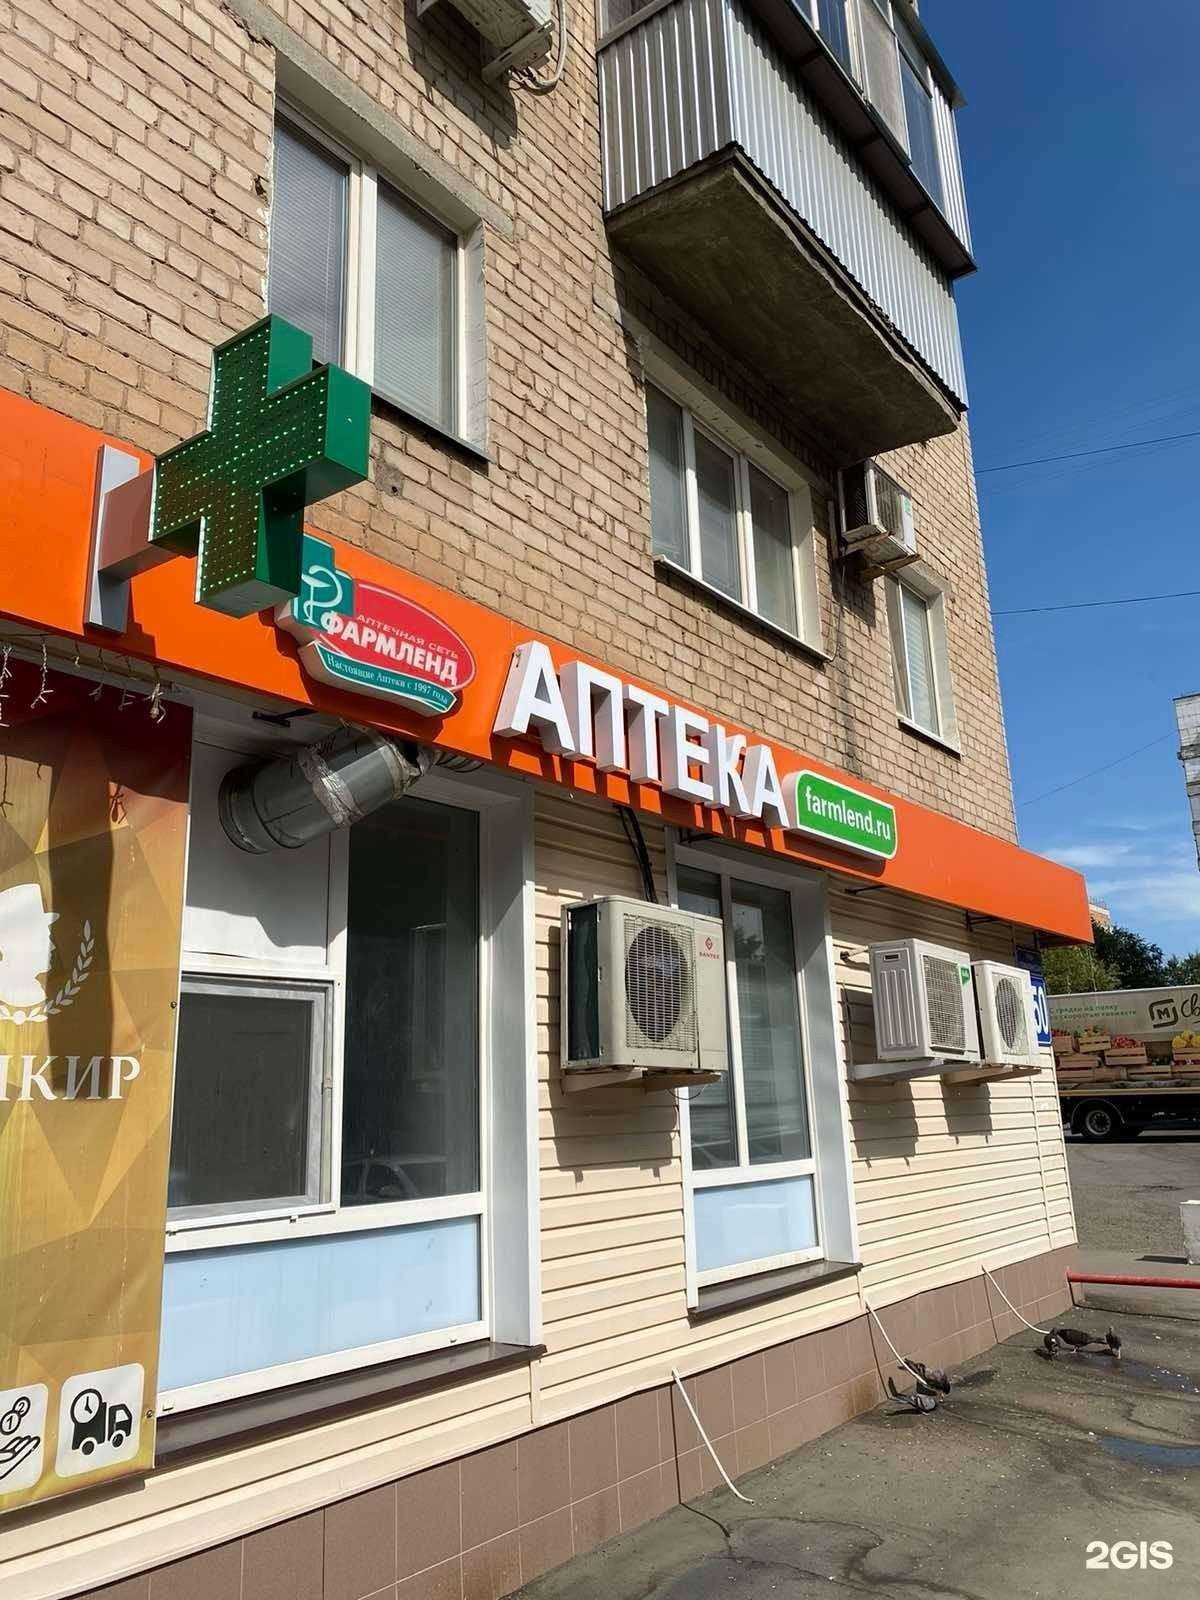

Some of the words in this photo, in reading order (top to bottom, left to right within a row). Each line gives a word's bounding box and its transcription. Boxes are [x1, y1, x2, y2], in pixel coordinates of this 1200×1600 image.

[320, 611, 459, 687] ФАРМЛЕНД
[357, 614, 425, 646] АПТЕЧНАЯ
[428, 642, 459, 660] СЕТЬ
[327, 653, 375, 681] Настоящие
[376, 673, 406, 688] Аптеки
[414, 681, 431, 695] 1997
[432, 689, 449, 705] года
[493, 640, 790, 829] АПТЕКА
[805, 785, 891, 840] farmlend.ru
